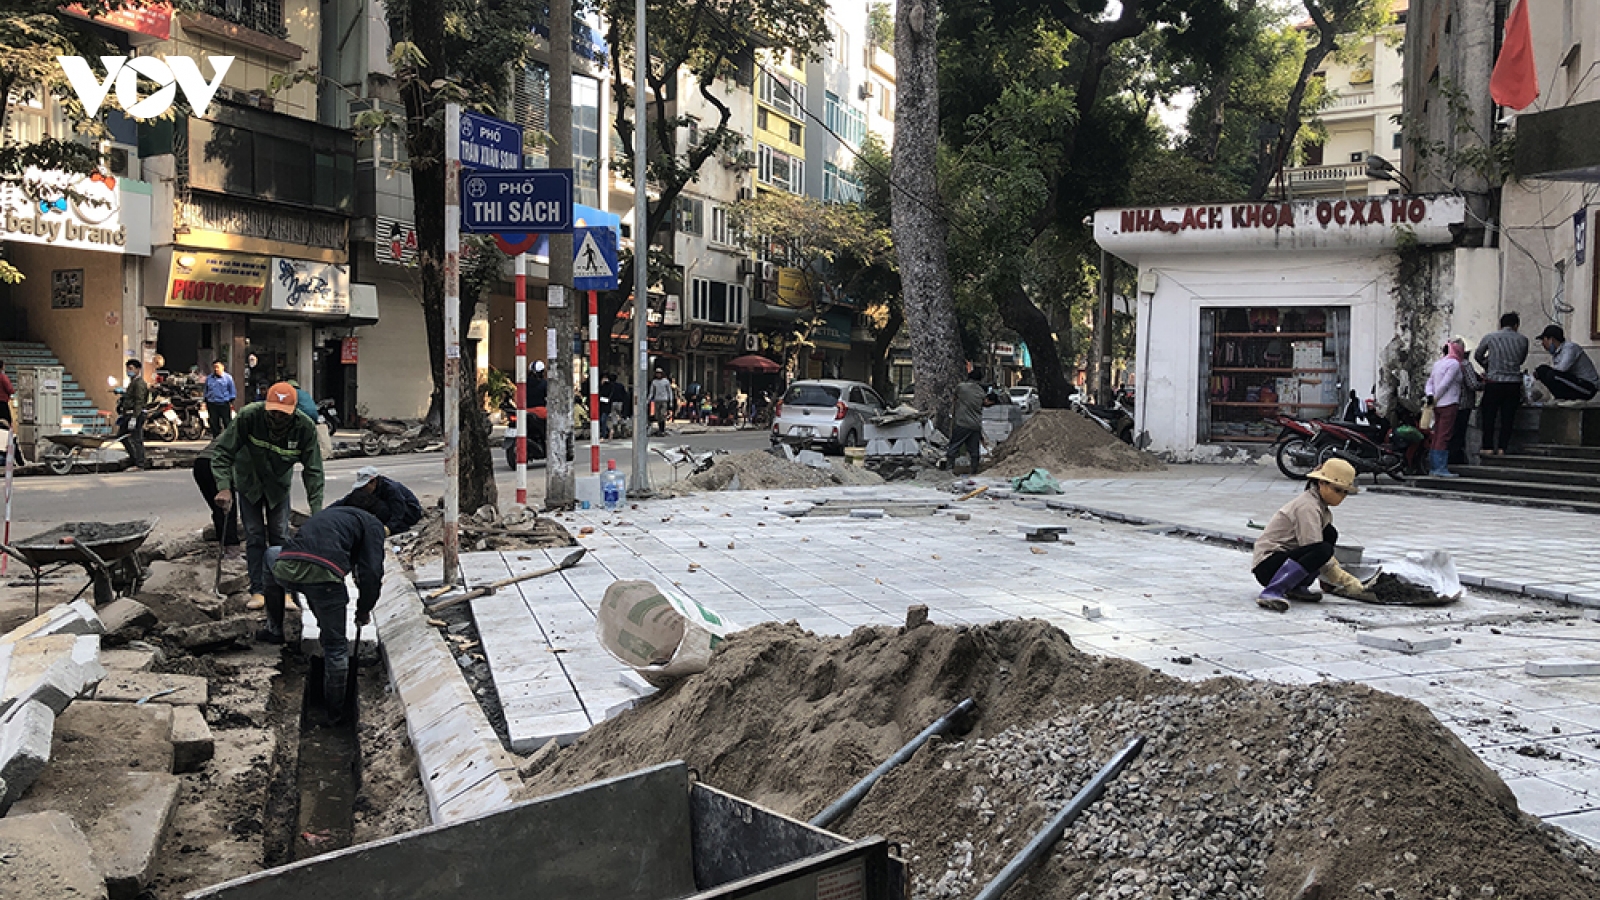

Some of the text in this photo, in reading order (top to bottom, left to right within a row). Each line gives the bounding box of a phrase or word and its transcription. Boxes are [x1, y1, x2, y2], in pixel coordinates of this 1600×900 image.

[479, 126, 502, 142] PHỐ
[498, 178, 535, 195] PHỐ
[472, 196, 561, 222] THI SÁCH
[1231, 203, 1294, 229] KHOA
[5, 208, 128, 246] baby brand
[172, 278, 265, 307] PHOTOCOPY
